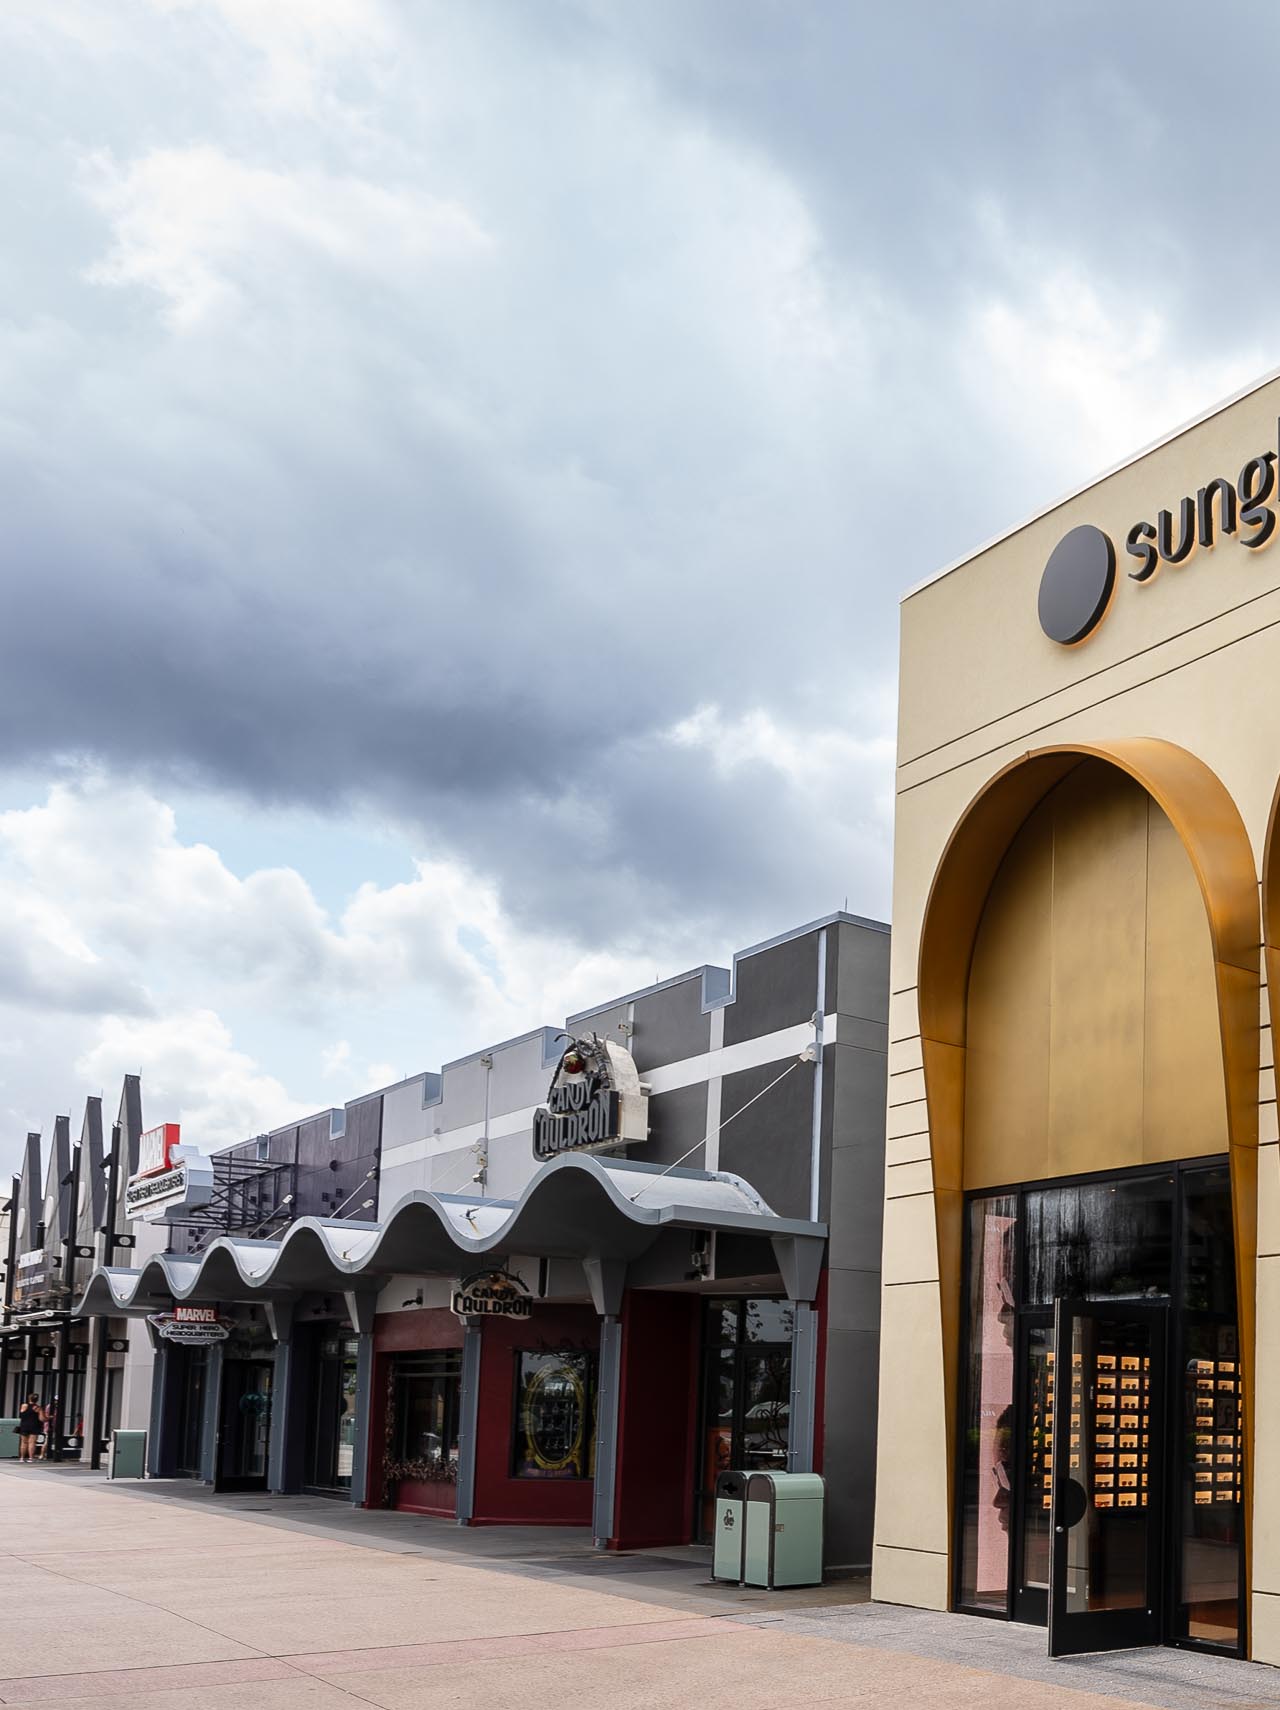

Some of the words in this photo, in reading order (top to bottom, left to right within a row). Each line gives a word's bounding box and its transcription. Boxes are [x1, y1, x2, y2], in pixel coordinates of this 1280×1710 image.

[549, 1078, 594, 1114] CANDY
[533, 1089, 612, 1163] CAULDRON
[176, 1307, 216, 1322] MARVEL
[453, 1292, 533, 1316] CAULDRON
